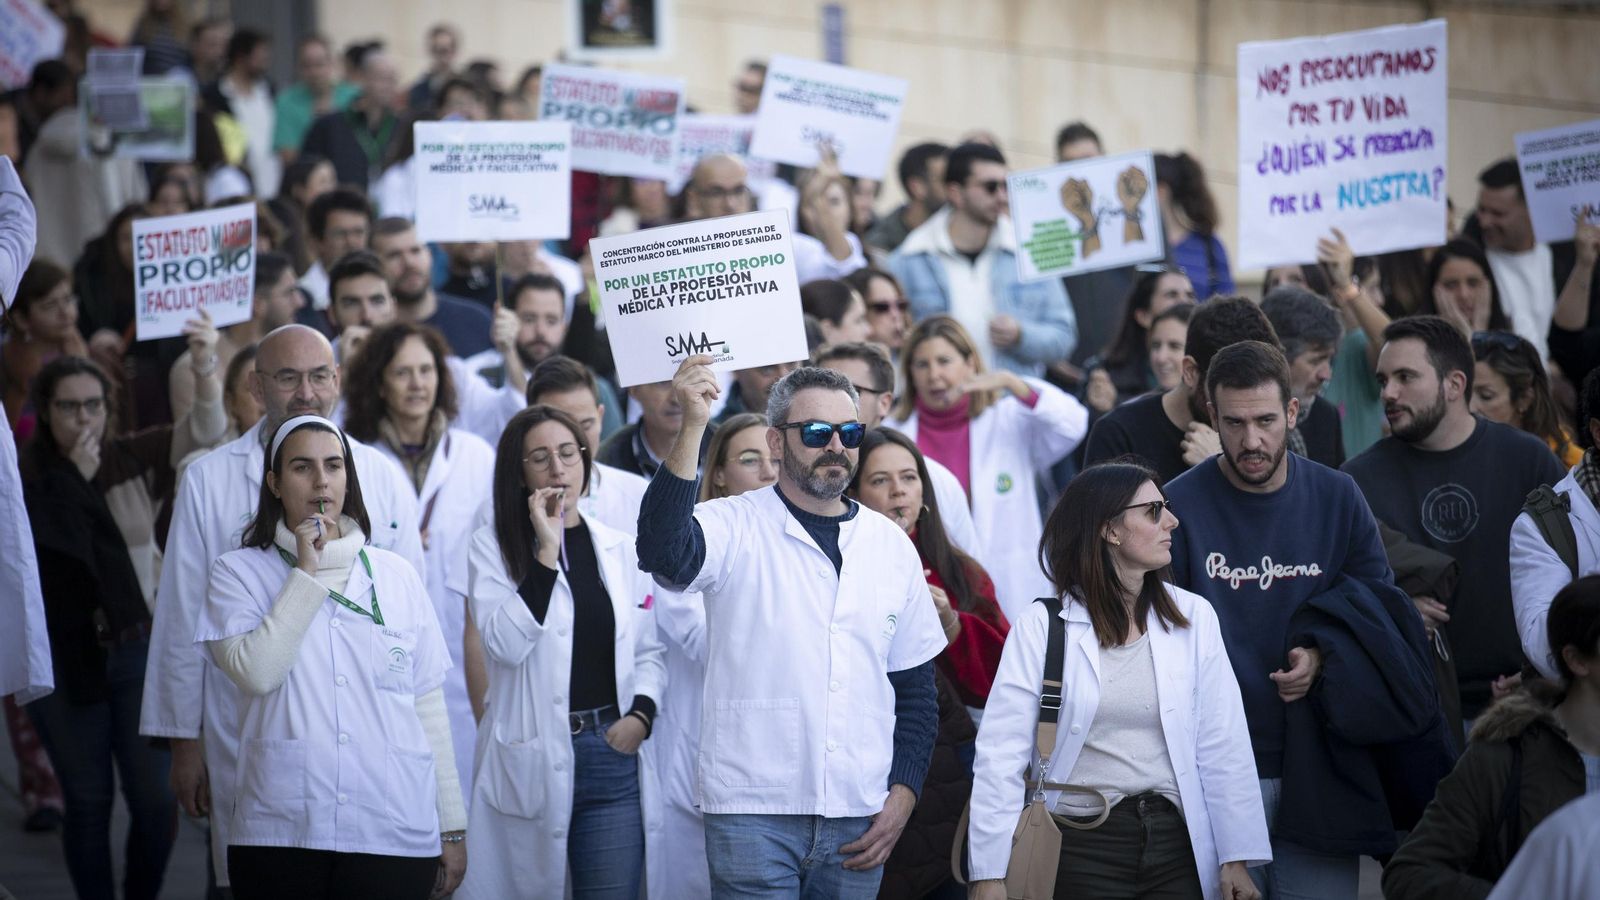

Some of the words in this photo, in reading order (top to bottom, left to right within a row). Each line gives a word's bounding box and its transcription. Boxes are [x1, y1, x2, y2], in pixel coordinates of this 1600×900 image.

[1257, 64, 1291, 97] NOS
[1301, 48, 1437, 87] PREOCUPAMOS
[1288, 102, 1320, 127] POR
[1326, 98, 1354, 122] TU
[1361, 95, 1408, 124] VIDA
[1333, 133, 1357, 161] SE
[1302, 192, 1322, 213] LA
[137, 226, 208, 263] ESTATUTO
[600, 255, 638, 269] ESTATUTO
[637, 251, 666, 262] MARCO
[666, 248, 682, 258] DEL
[682, 241, 731, 256] MINISTERIO
[732, 238, 743, 248] DE
[745, 233, 783, 246] SANIDAD
[602, 241, 666, 260] CONCENTRACIÓN
[666, 236, 700, 249] CONTRA
[701, 234, 713, 243] LA
[713, 228, 763, 242] PROPUESTA
[764, 224, 776, 234] DE
[139, 247, 253, 288] PROPIO
[604, 278, 630, 292] POR
[631, 273, 651, 287] UN
[653, 261, 727, 284] ESTATUTO
[729, 252, 786, 272] PROPIO
[632, 286, 649, 301] DE
[651, 283, 669, 298] LA
[670, 269, 752, 294] PROFESIÓN
[618, 299, 665, 316] MÉDICA
[664, 295, 676, 307] Y
[679, 280, 779, 306] FACULTATIVA
[665, 331, 725, 358] SMA
[1205, 551, 1260, 590] Pepe
[1258, 555, 1323, 591] Jeans
